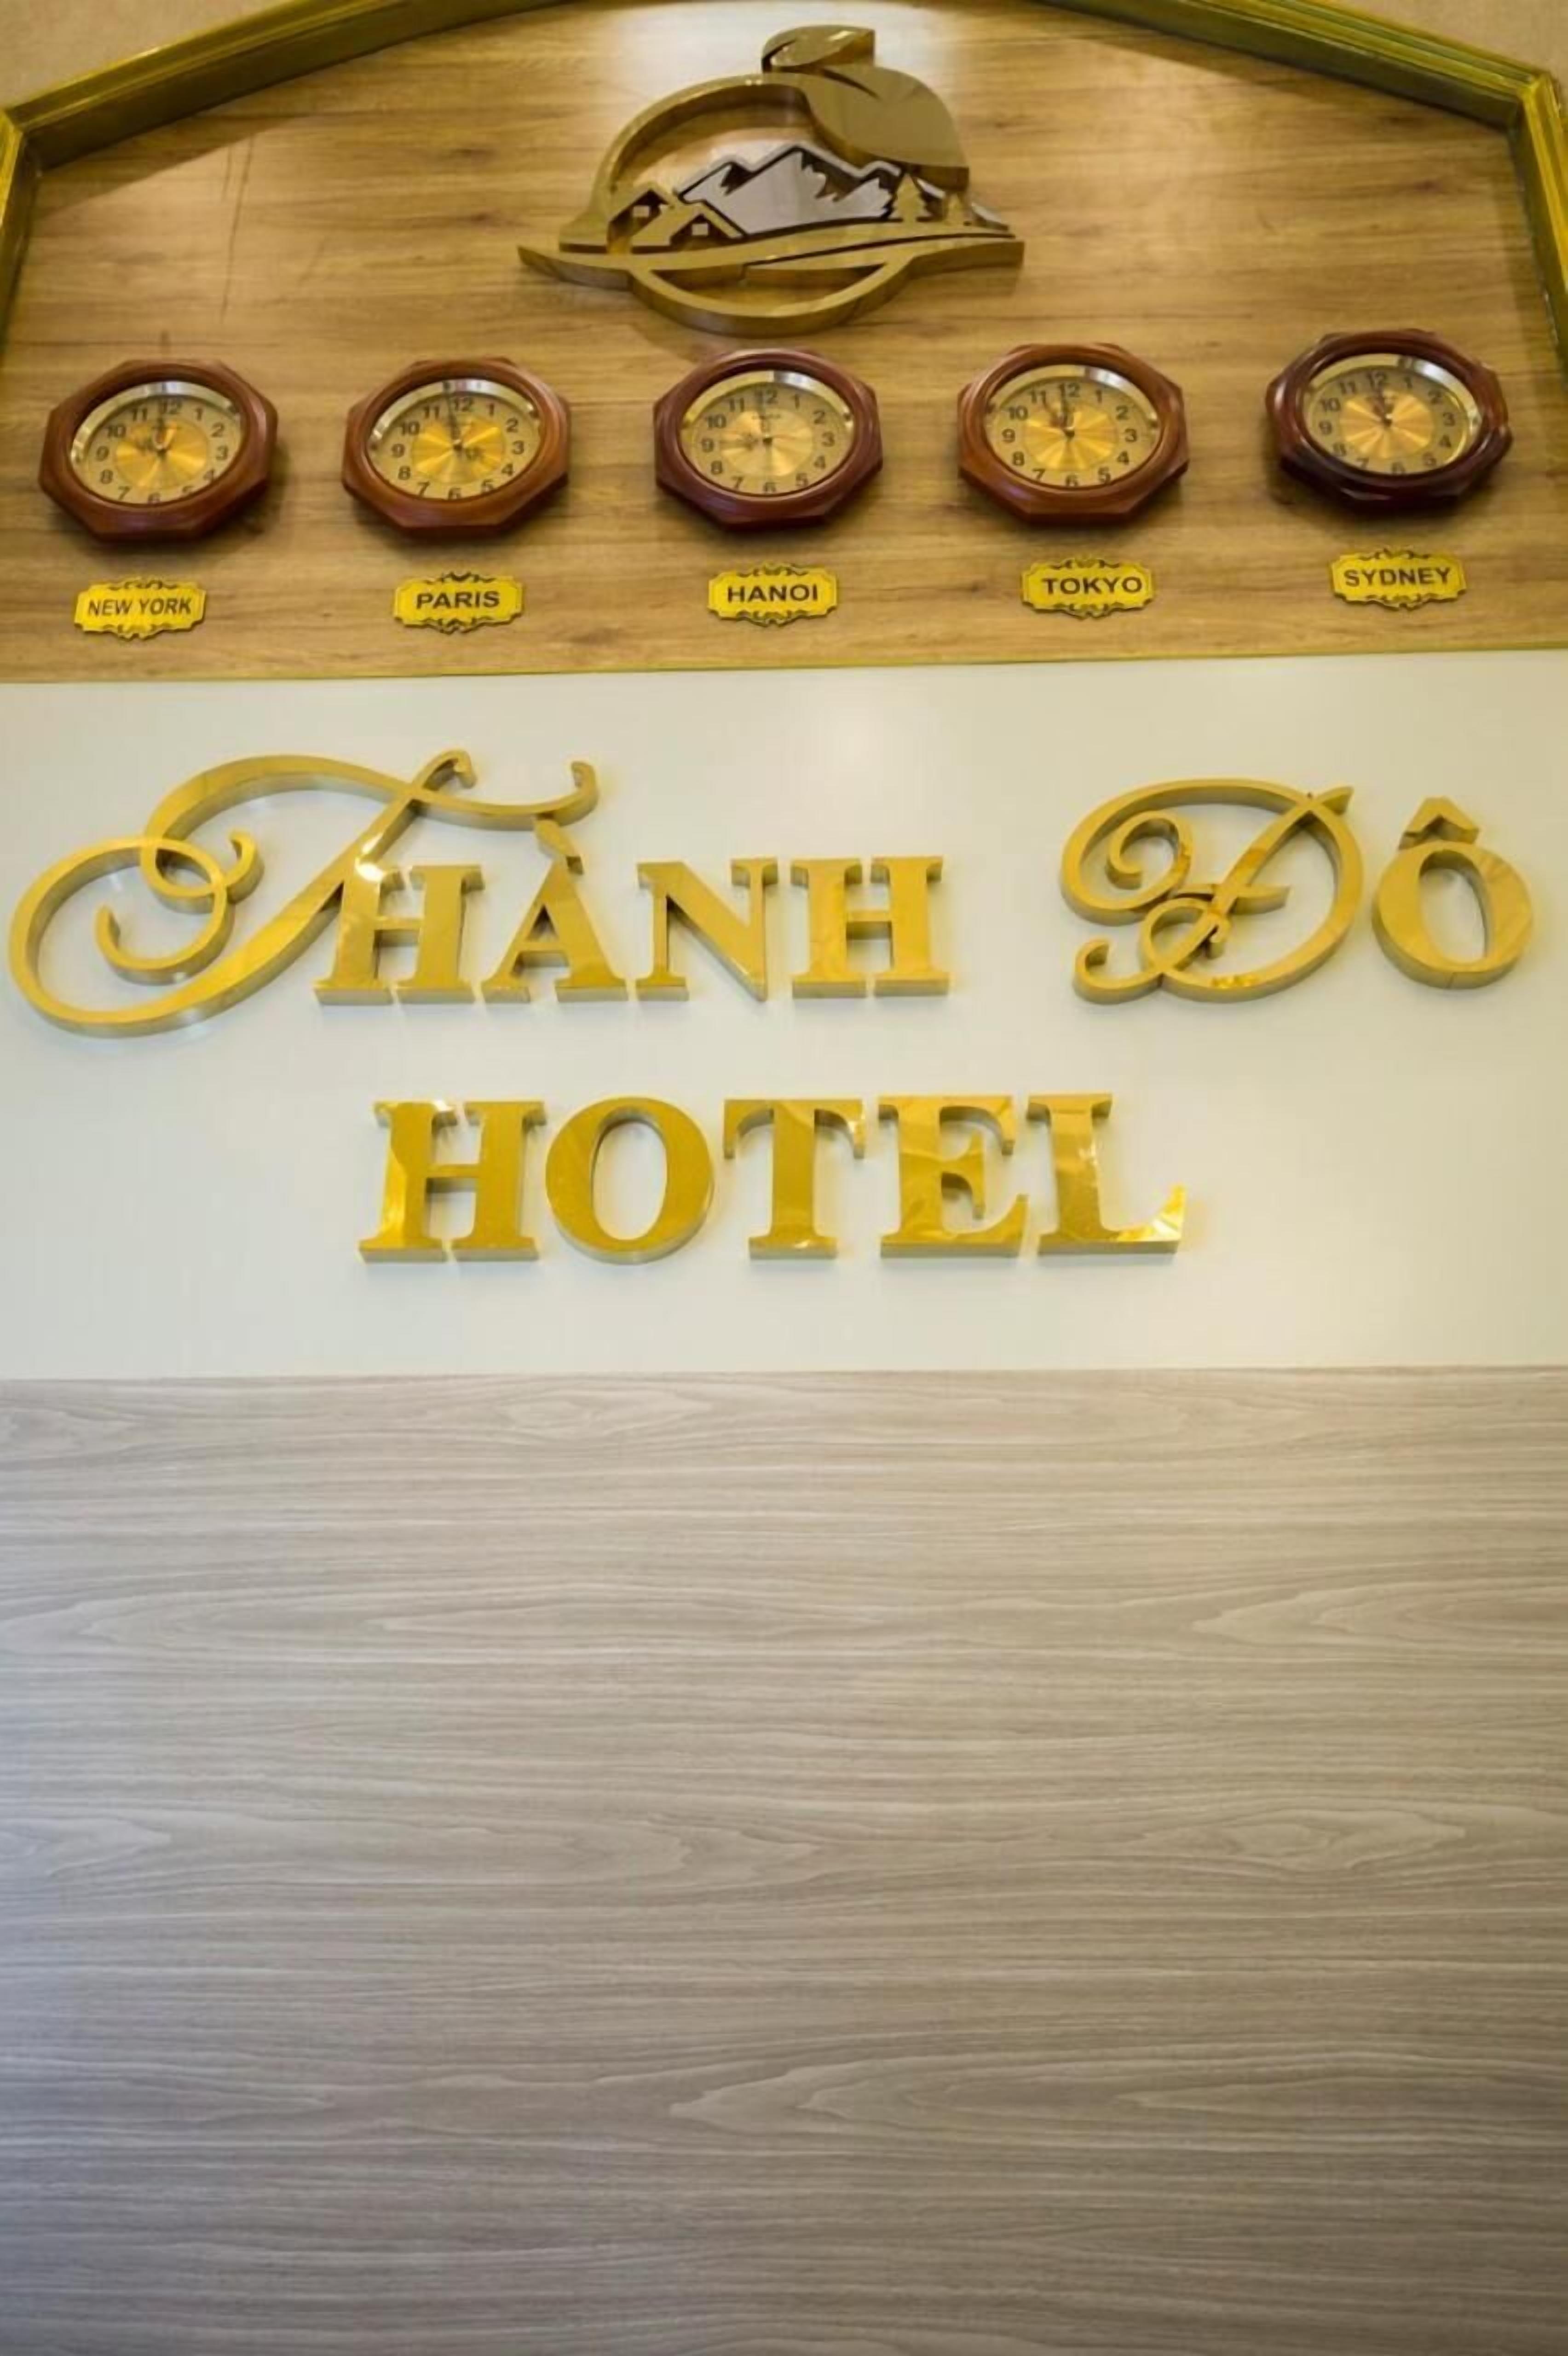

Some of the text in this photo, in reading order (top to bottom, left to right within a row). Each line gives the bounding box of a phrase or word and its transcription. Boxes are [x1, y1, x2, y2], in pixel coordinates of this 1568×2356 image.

[1367, 373, 1387, 386] 12
[1405, 377, 1413, 388] 1
[1060, 383, 1080, 398] 12
[1341, 381, 1356, 393] 11
[793, 395, 800, 408] 1
[1030, 391, 1046, 403] 11
[1095, 390, 1103, 403] 1
[454, 398, 473, 411] 12
[488, 404, 495, 415] 1
[729, 398, 745, 411] 11
[1320, 398, 1340, 412] 10
[133, 409, 148, 421] 11
[196, 409, 203, 420] 1
[424, 407, 440, 419] 11
[814, 410, 825, 423] 2
[1009, 406, 1028, 420] 10
[1116, 406, 1128, 419] 2
[506, 419, 519, 431] 2
[707, 415, 726, 428] 10
[1443, 413, 1455, 426] 3
[107, 425, 127, 437] 10
[211, 424, 225, 437] 2
[401, 422, 421, 435] 10
[1319, 422, 1332, 434] 9
[822, 432, 835, 446] 3
[1002, 429, 1015, 443] 9
[1124, 429, 1137, 442] 3
[391, 444, 405, 458] 9
[512, 441, 525, 455] 3
[701, 439, 714, 452] 9
[96, 446, 109, 459] 9
[216, 446, 229, 460] 3
[1012, 452, 1025, 465] 8
[1117, 451, 1129, 465] 4
[711, 461, 723, 474] 8
[814, 456, 825, 468] 4
[203, 469, 215, 481] 4
[398, 467, 411, 480] 8
[502, 464, 514, 476] 4
[1032, 469, 1045, 481] 7
[1098, 468, 1111, 482] 5
[100, 470, 114, 484] 8
[732, 477, 743, 489] 7
[796, 474, 808, 486] 5
[1066, 475, 1078, 487] 6
[417, 482, 430, 496] 7
[481, 480, 494, 492] 5
[763, 482, 776, 493] 6
[118, 486, 130, 500] 7
[449, 488, 461, 499] 6
[1343, 567, 1450, 587] SYDNEY
[1041, 577, 1142, 595] TOKYO
[416, 591, 500, 609] PARIS
[727, 584, 818, 603] HANOI
[88, 598, 191, 617] NEW YORK
[358, 1092, 1188, 1265] HOTEL
